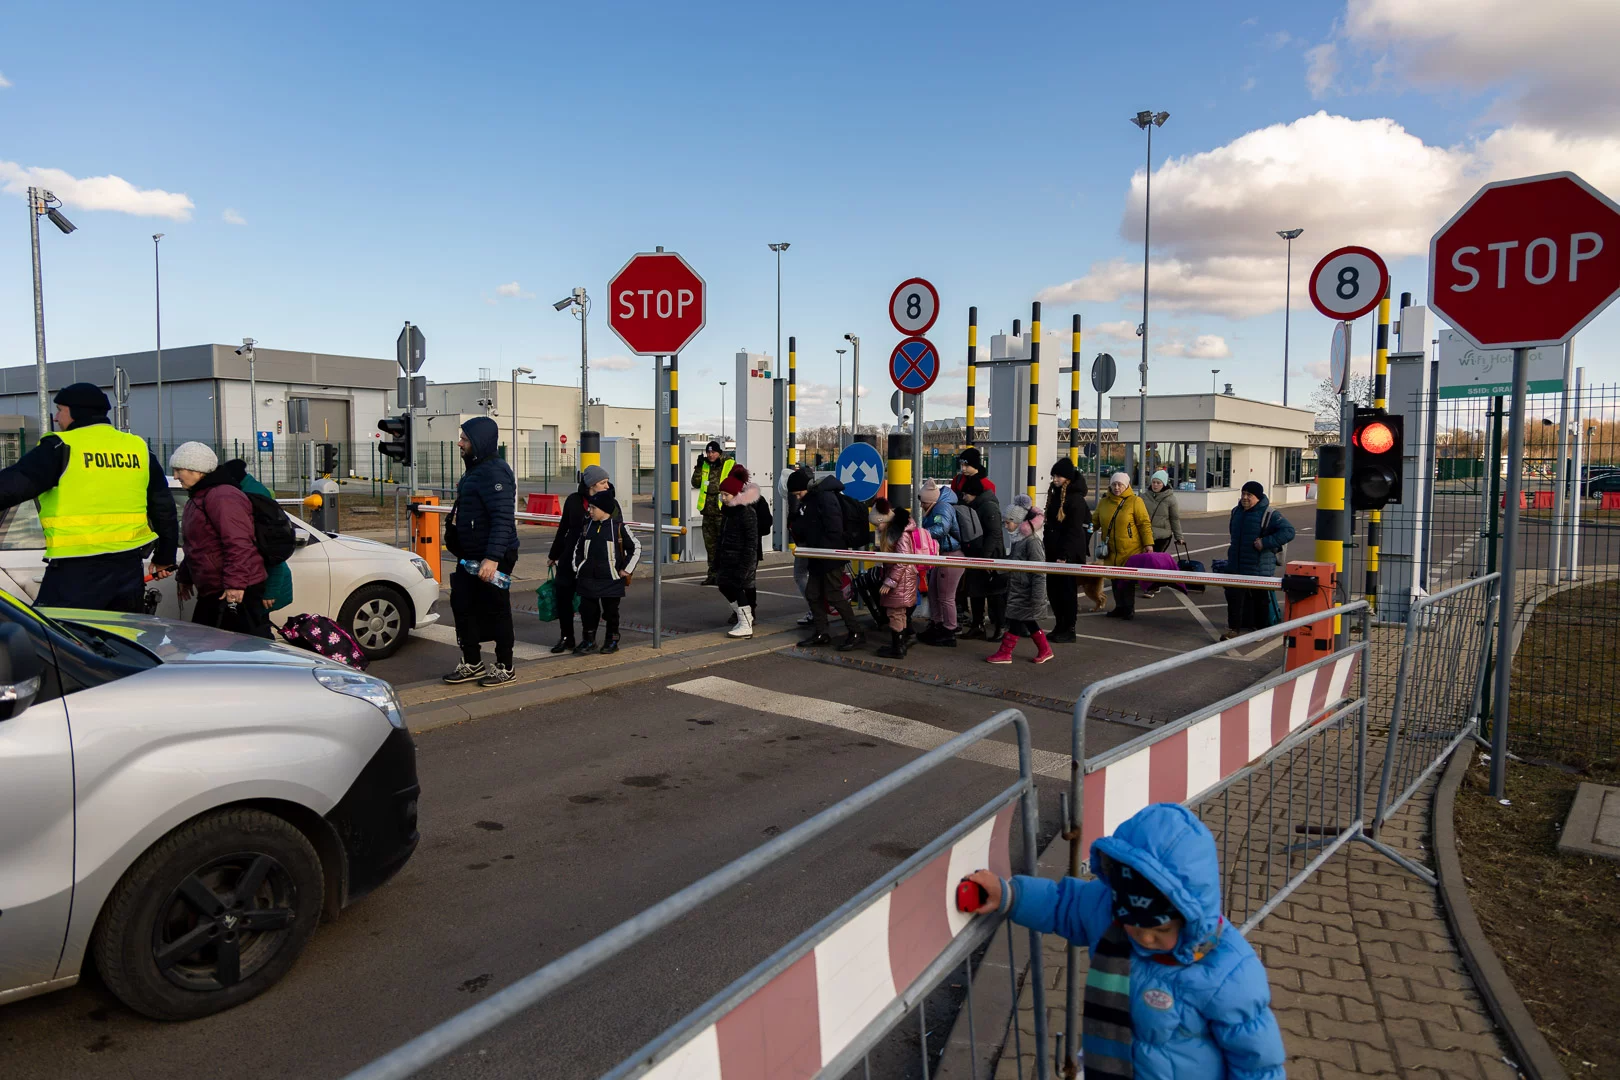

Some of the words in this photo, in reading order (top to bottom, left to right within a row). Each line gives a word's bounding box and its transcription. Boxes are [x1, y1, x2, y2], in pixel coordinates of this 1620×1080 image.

[1450, 231, 1604, 293] STOP
[1336, 266, 1360, 300] 8
[619, 289, 695, 319] STOP
[906, 293, 922, 320] 8
[1467, 387, 1490, 395] SSID:
[83, 452, 141, 469] POLICJA
